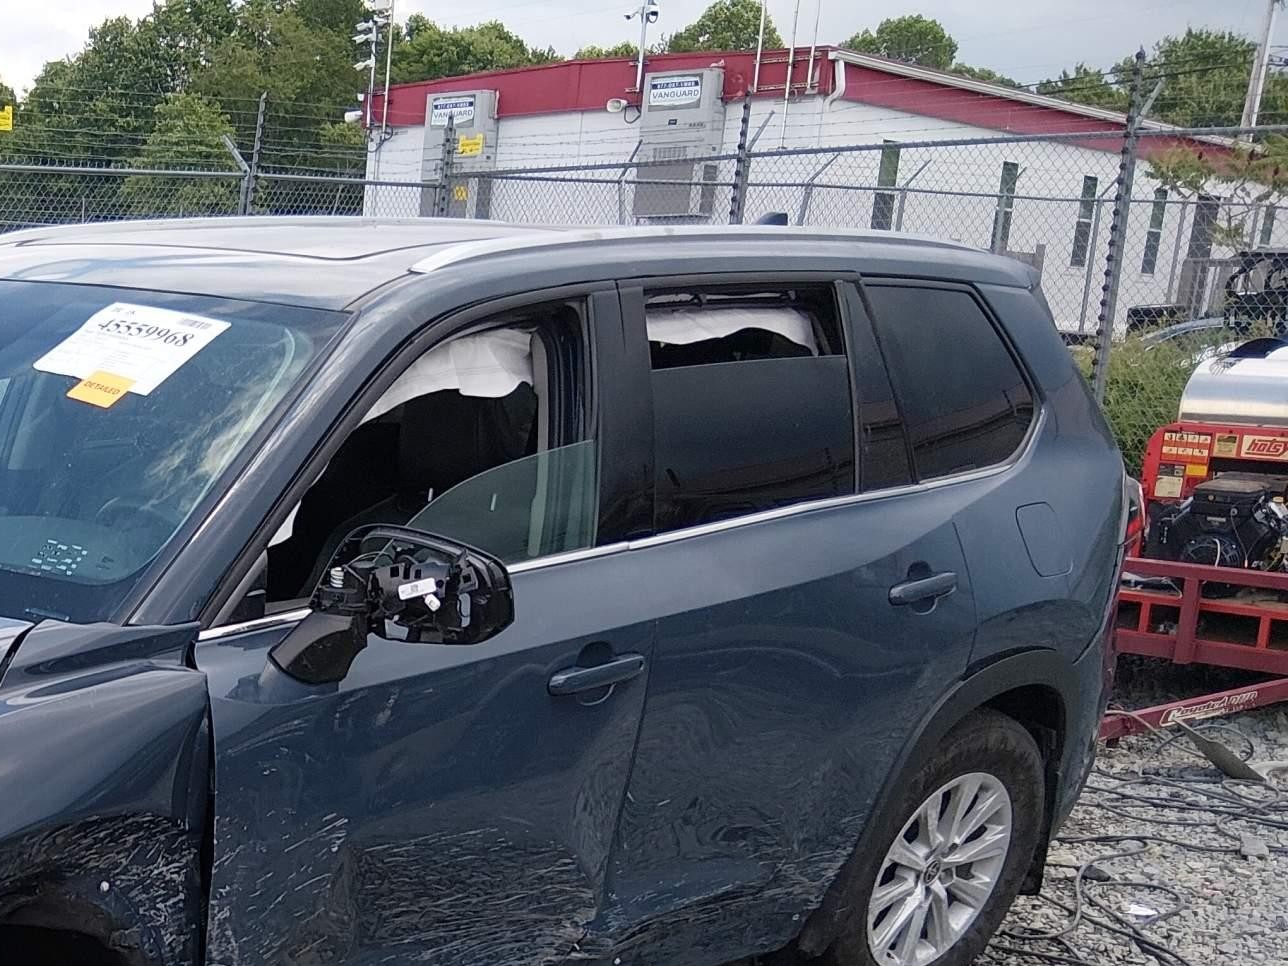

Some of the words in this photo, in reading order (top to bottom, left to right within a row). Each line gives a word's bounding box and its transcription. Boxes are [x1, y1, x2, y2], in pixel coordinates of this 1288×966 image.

[653, 89, 699, 99] VANGUARD
[433, 109, 472, 119] VANUARD
[98, 319, 195, 347] 45559968
[83, 380, 121, 395] DETAILED
